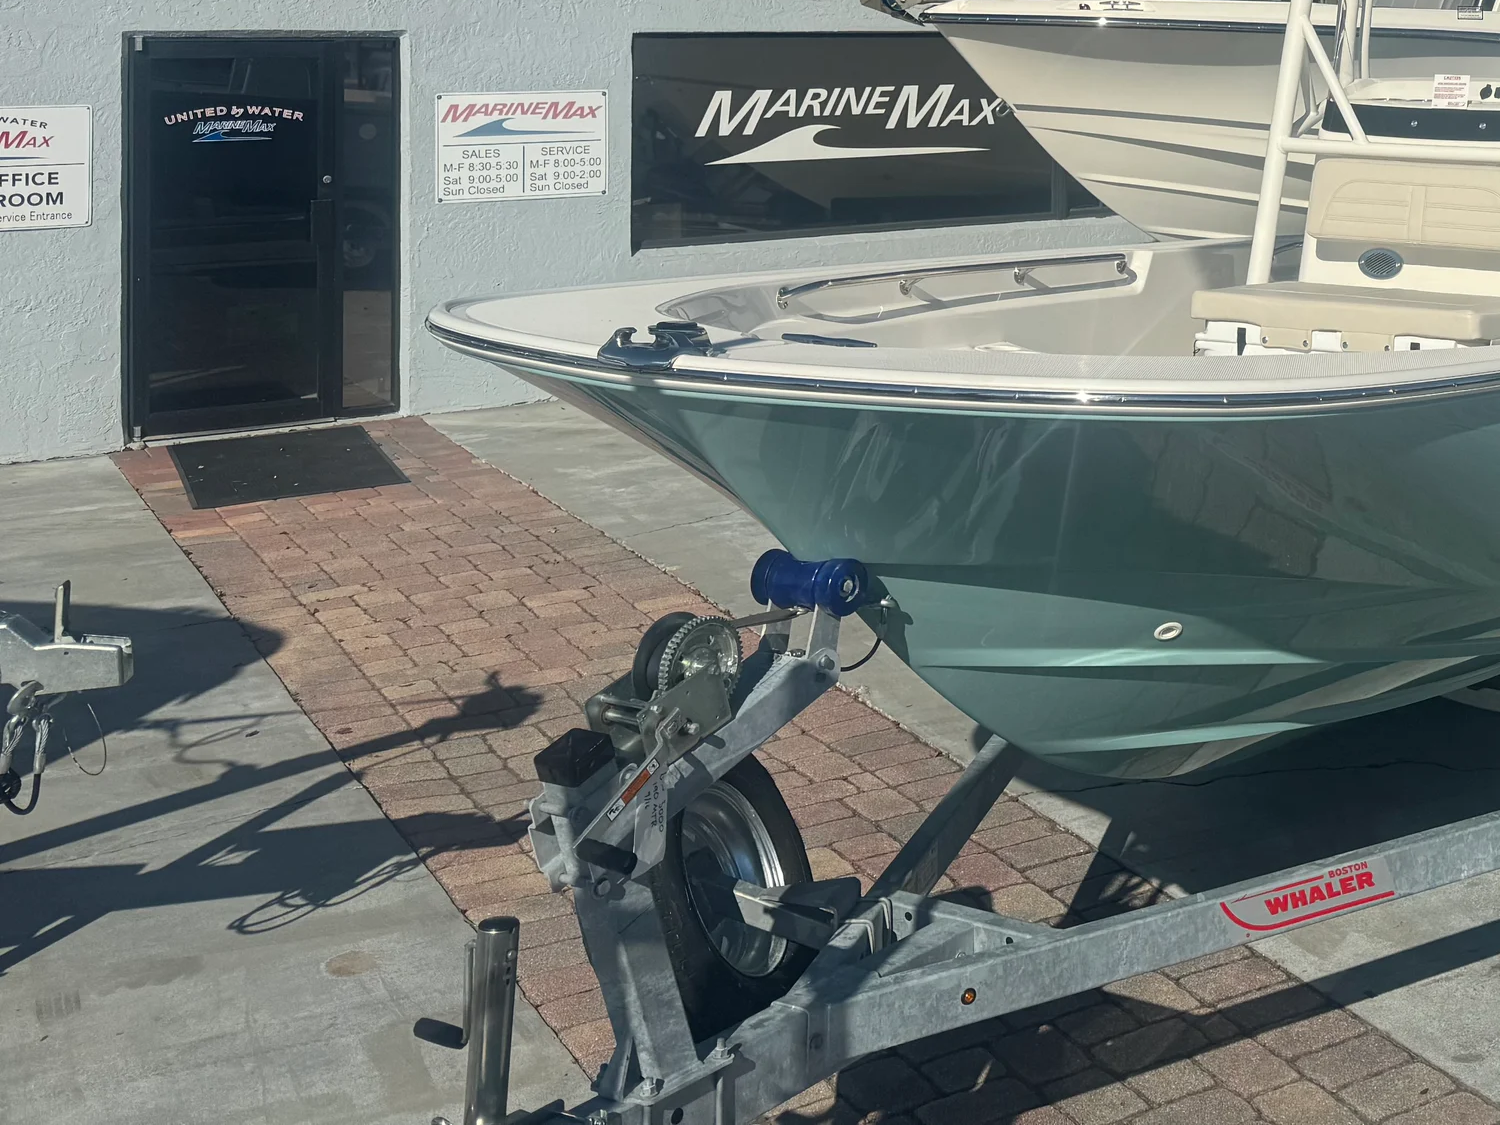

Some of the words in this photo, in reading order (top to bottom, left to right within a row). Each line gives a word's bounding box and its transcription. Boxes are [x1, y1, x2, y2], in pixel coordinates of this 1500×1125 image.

[164, 106, 227, 125] UNITED
[231, 105, 244, 117] by
[247, 105, 304, 121] WATER
[440, 101, 603, 123] MARINEMAX
[694, 84, 1001, 137] MARINEMAX
[193, 120, 276, 134] MARINEMAX
[462, 148, 501, 159] SALES
[541, 145, 590, 156] SERVICE
[443, 162, 465, 172] M-F
[468, 160, 518, 172] 8:30-5:30
[529, 159, 550, 168] M-F
[553, 157, 601, 167] 8:00-5:00
[443, 175, 462, 185] Sat
[468, 173, 518, 184] 9:00-5:00
[529, 172, 547, 181] Sat
[553, 169, 601, 180] 9:00-2:00
[443, 187, 464, 196] Sun
[468, 185, 505, 195] Closed
[529, 183, 550, 192] Sun
[553, 181, 589, 191] Closed
[29, 211, 72, 221] Entrance
[1327, 860, 1368, 878] BOSTON
[1264, 871, 1375, 915] WHALER
